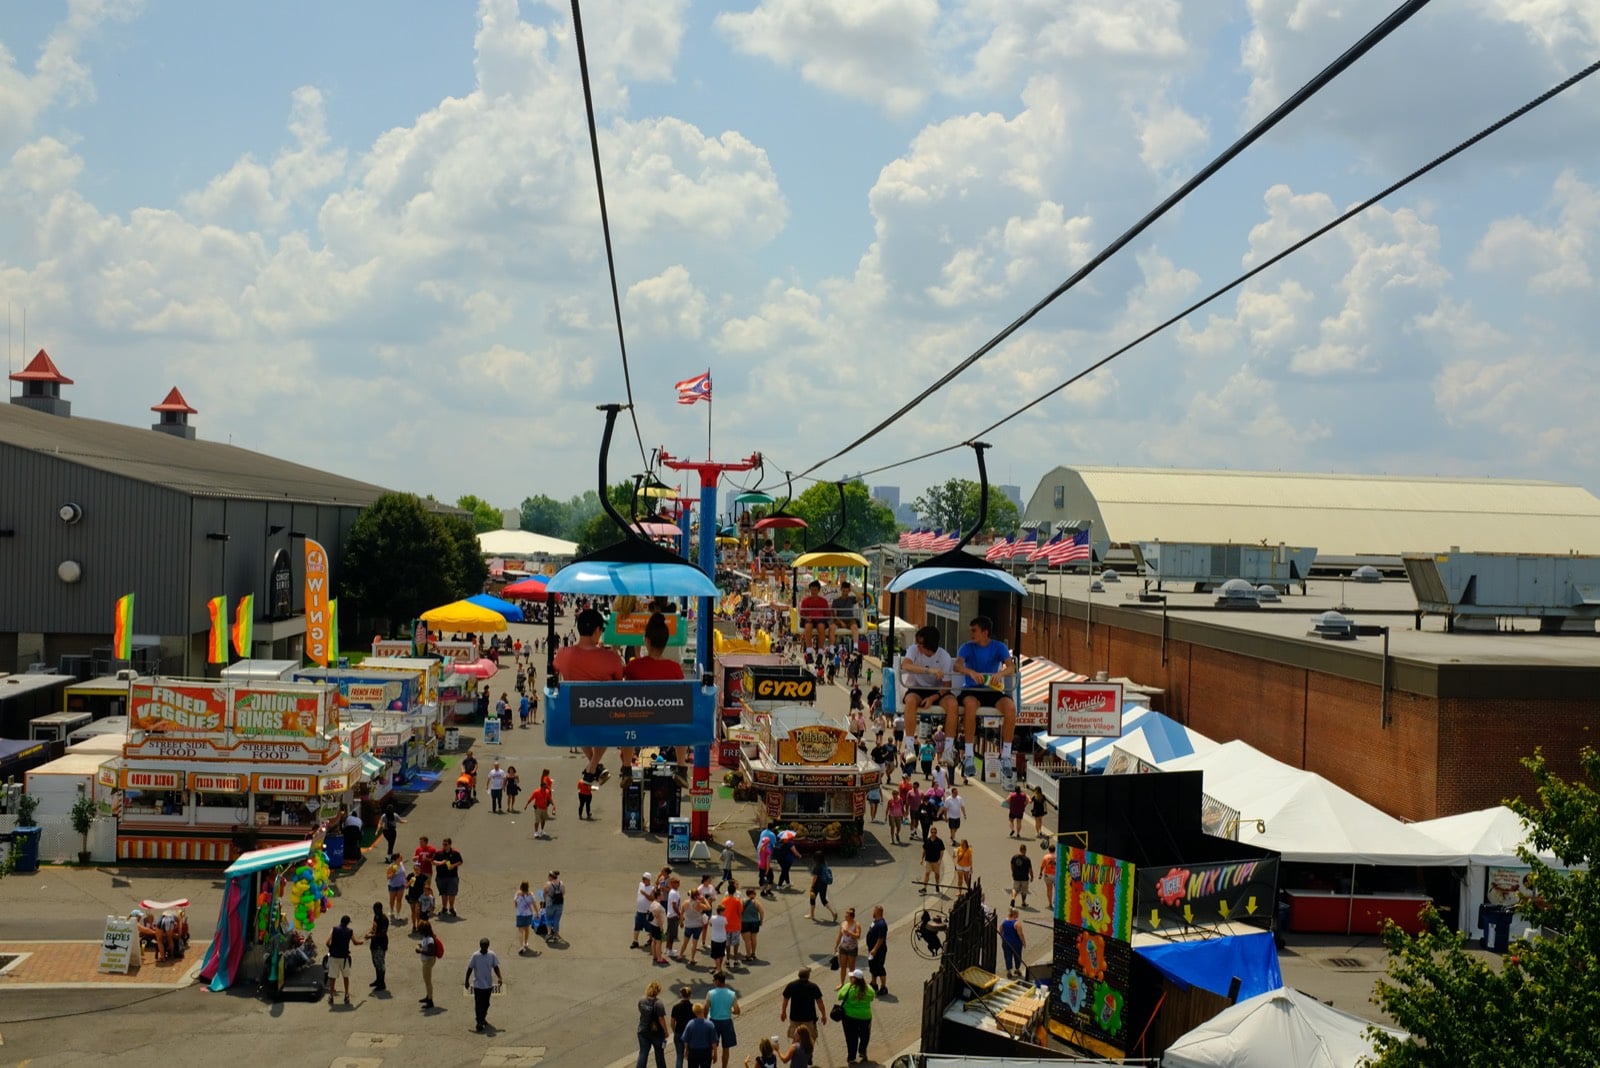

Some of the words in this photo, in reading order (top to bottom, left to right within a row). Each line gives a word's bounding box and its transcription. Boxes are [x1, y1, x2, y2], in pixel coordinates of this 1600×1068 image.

[758, 680, 813, 698] GYRO
[152, 687, 207, 714] FRIED
[251, 693, 298, 712] ONION
[579, 697, 684, 708] BeSafeOhio.com
[1058, 692, 1106, 714] Schmidt's
[136, 702, 220, 729] VEGGIES
[236, 710, 284, 730] RINGS
[625, 731, 636, 740] 75
[149, 740, 188, 749] STREET
[242, 744, 278, 752] STREET
[280, 745, 301, 753] SIDE
[159, 748, 197, 757] FOOD
[252, 752, 290, 760] FOOD
[132, 774, 152, 785] ONION
[154, 774, 175, 786] RINGS
[196, 777, 214, 788] FRIED
[216, 778, 240, 789] VEGGIES
[262, 778, 284, 790] ONION
[285, 779, 305, 790] RINGS
[1082, 864, 1100, 883] MIX
[1187, 868, 1221, 900] MIX
[1217, 864, 1236, 892] IT
[1232, 862, 1258, 887] UP!
[106, 932, 130, 941] RIDES
